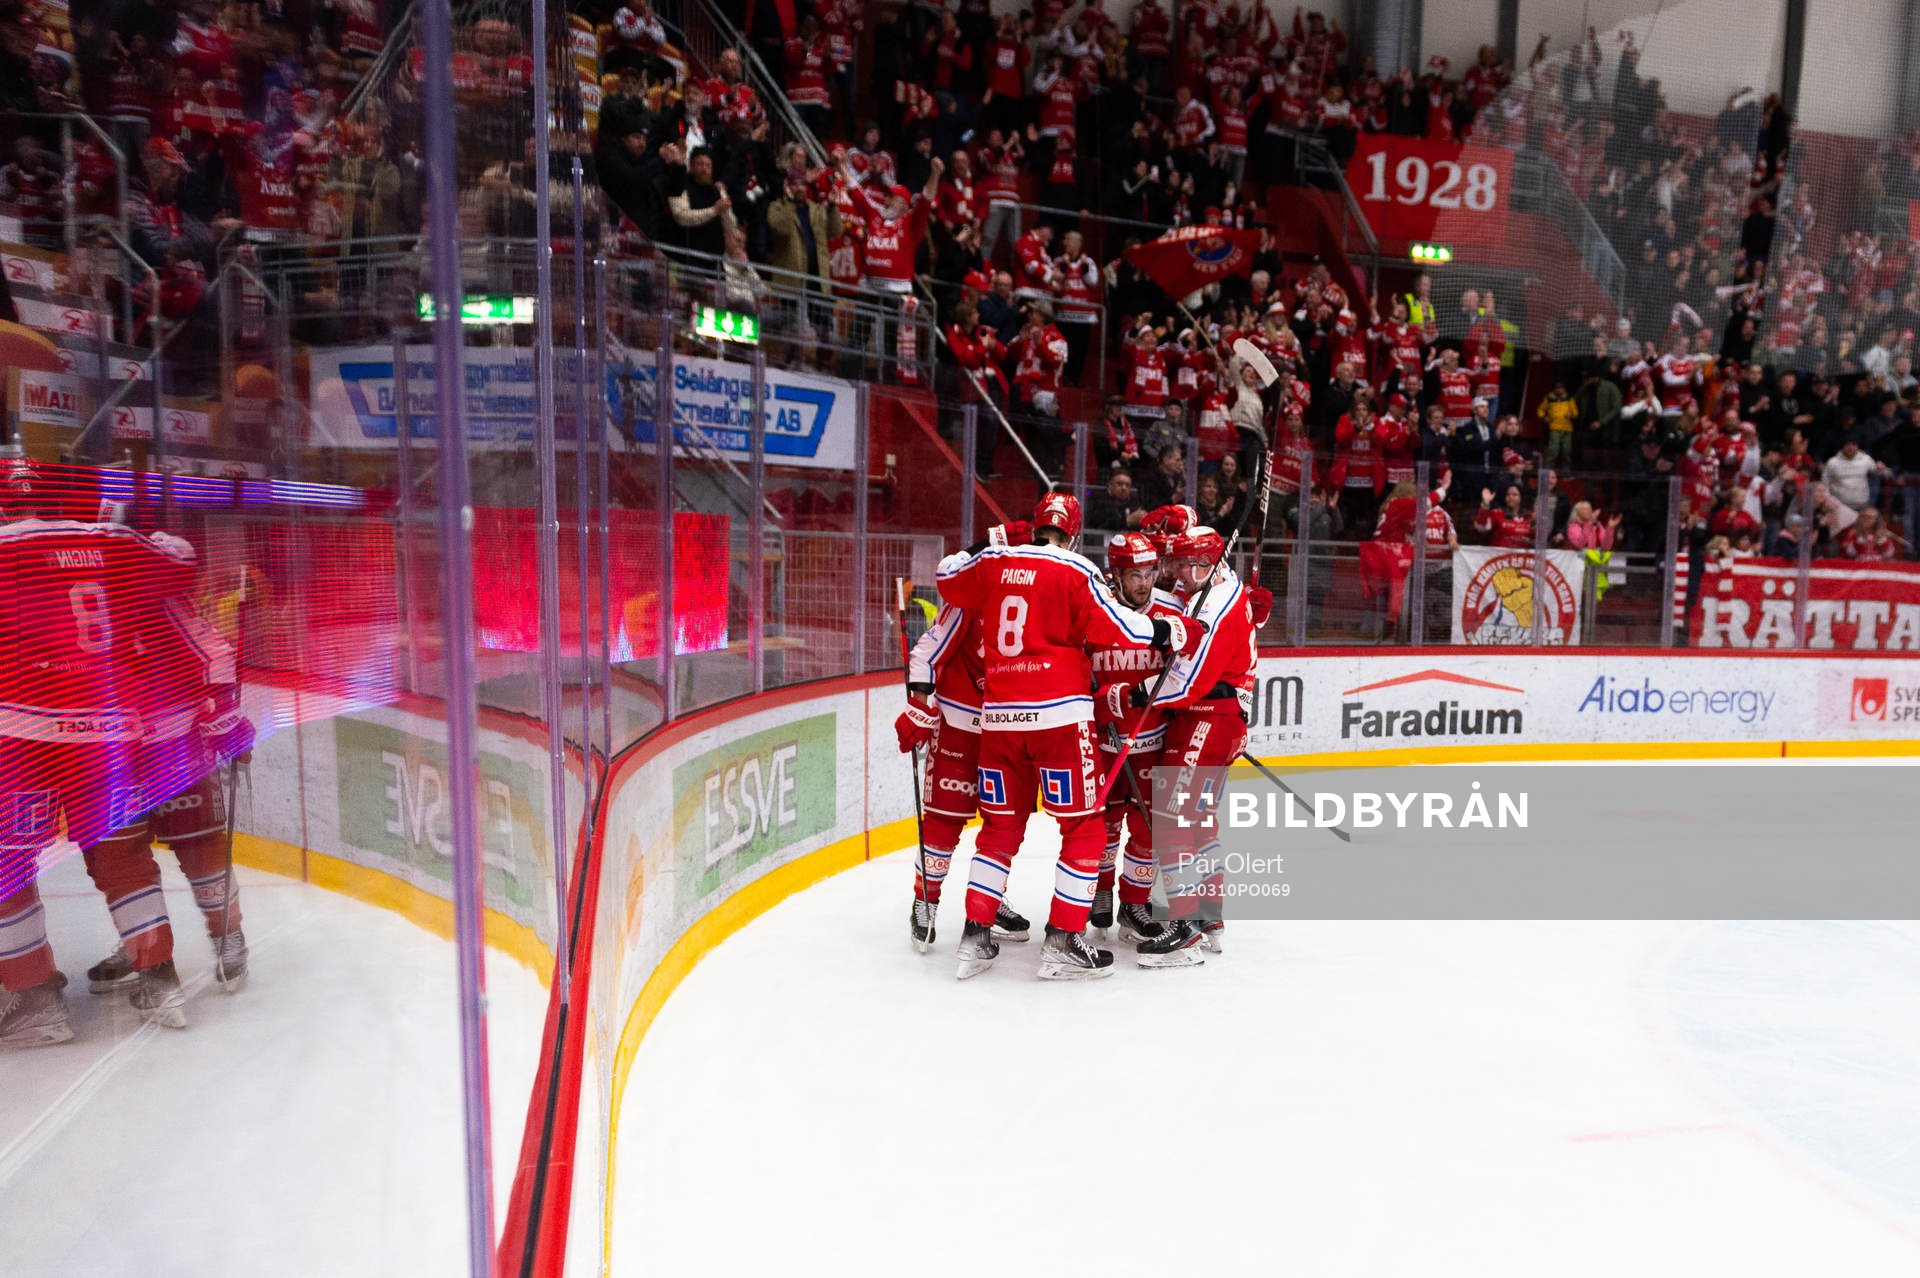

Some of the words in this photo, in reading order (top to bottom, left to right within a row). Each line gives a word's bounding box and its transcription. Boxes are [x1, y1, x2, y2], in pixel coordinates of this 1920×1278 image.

[1363, 151, 1497, 211] 1928
[674, 364, 771, 402] Selånges
[776, 407, 801, 433] AB
[1051, 514, 1060, 524] 8
[1000, 568, 1037, 586] PAIGIN
[998, 595, 1028, 657] 8
[1010, 660, 1026, 673] with
[1027, 660, 1042, 673] love
[985, 712, 1040, 723] BILBOLAGET
[1341, 701, 1523, 739] Faradium
[1077, 723, 1097, 797] PEAB
[1172, 728, 1209, 800] PEAB
[704, 742, 798, 868] ESSVE
